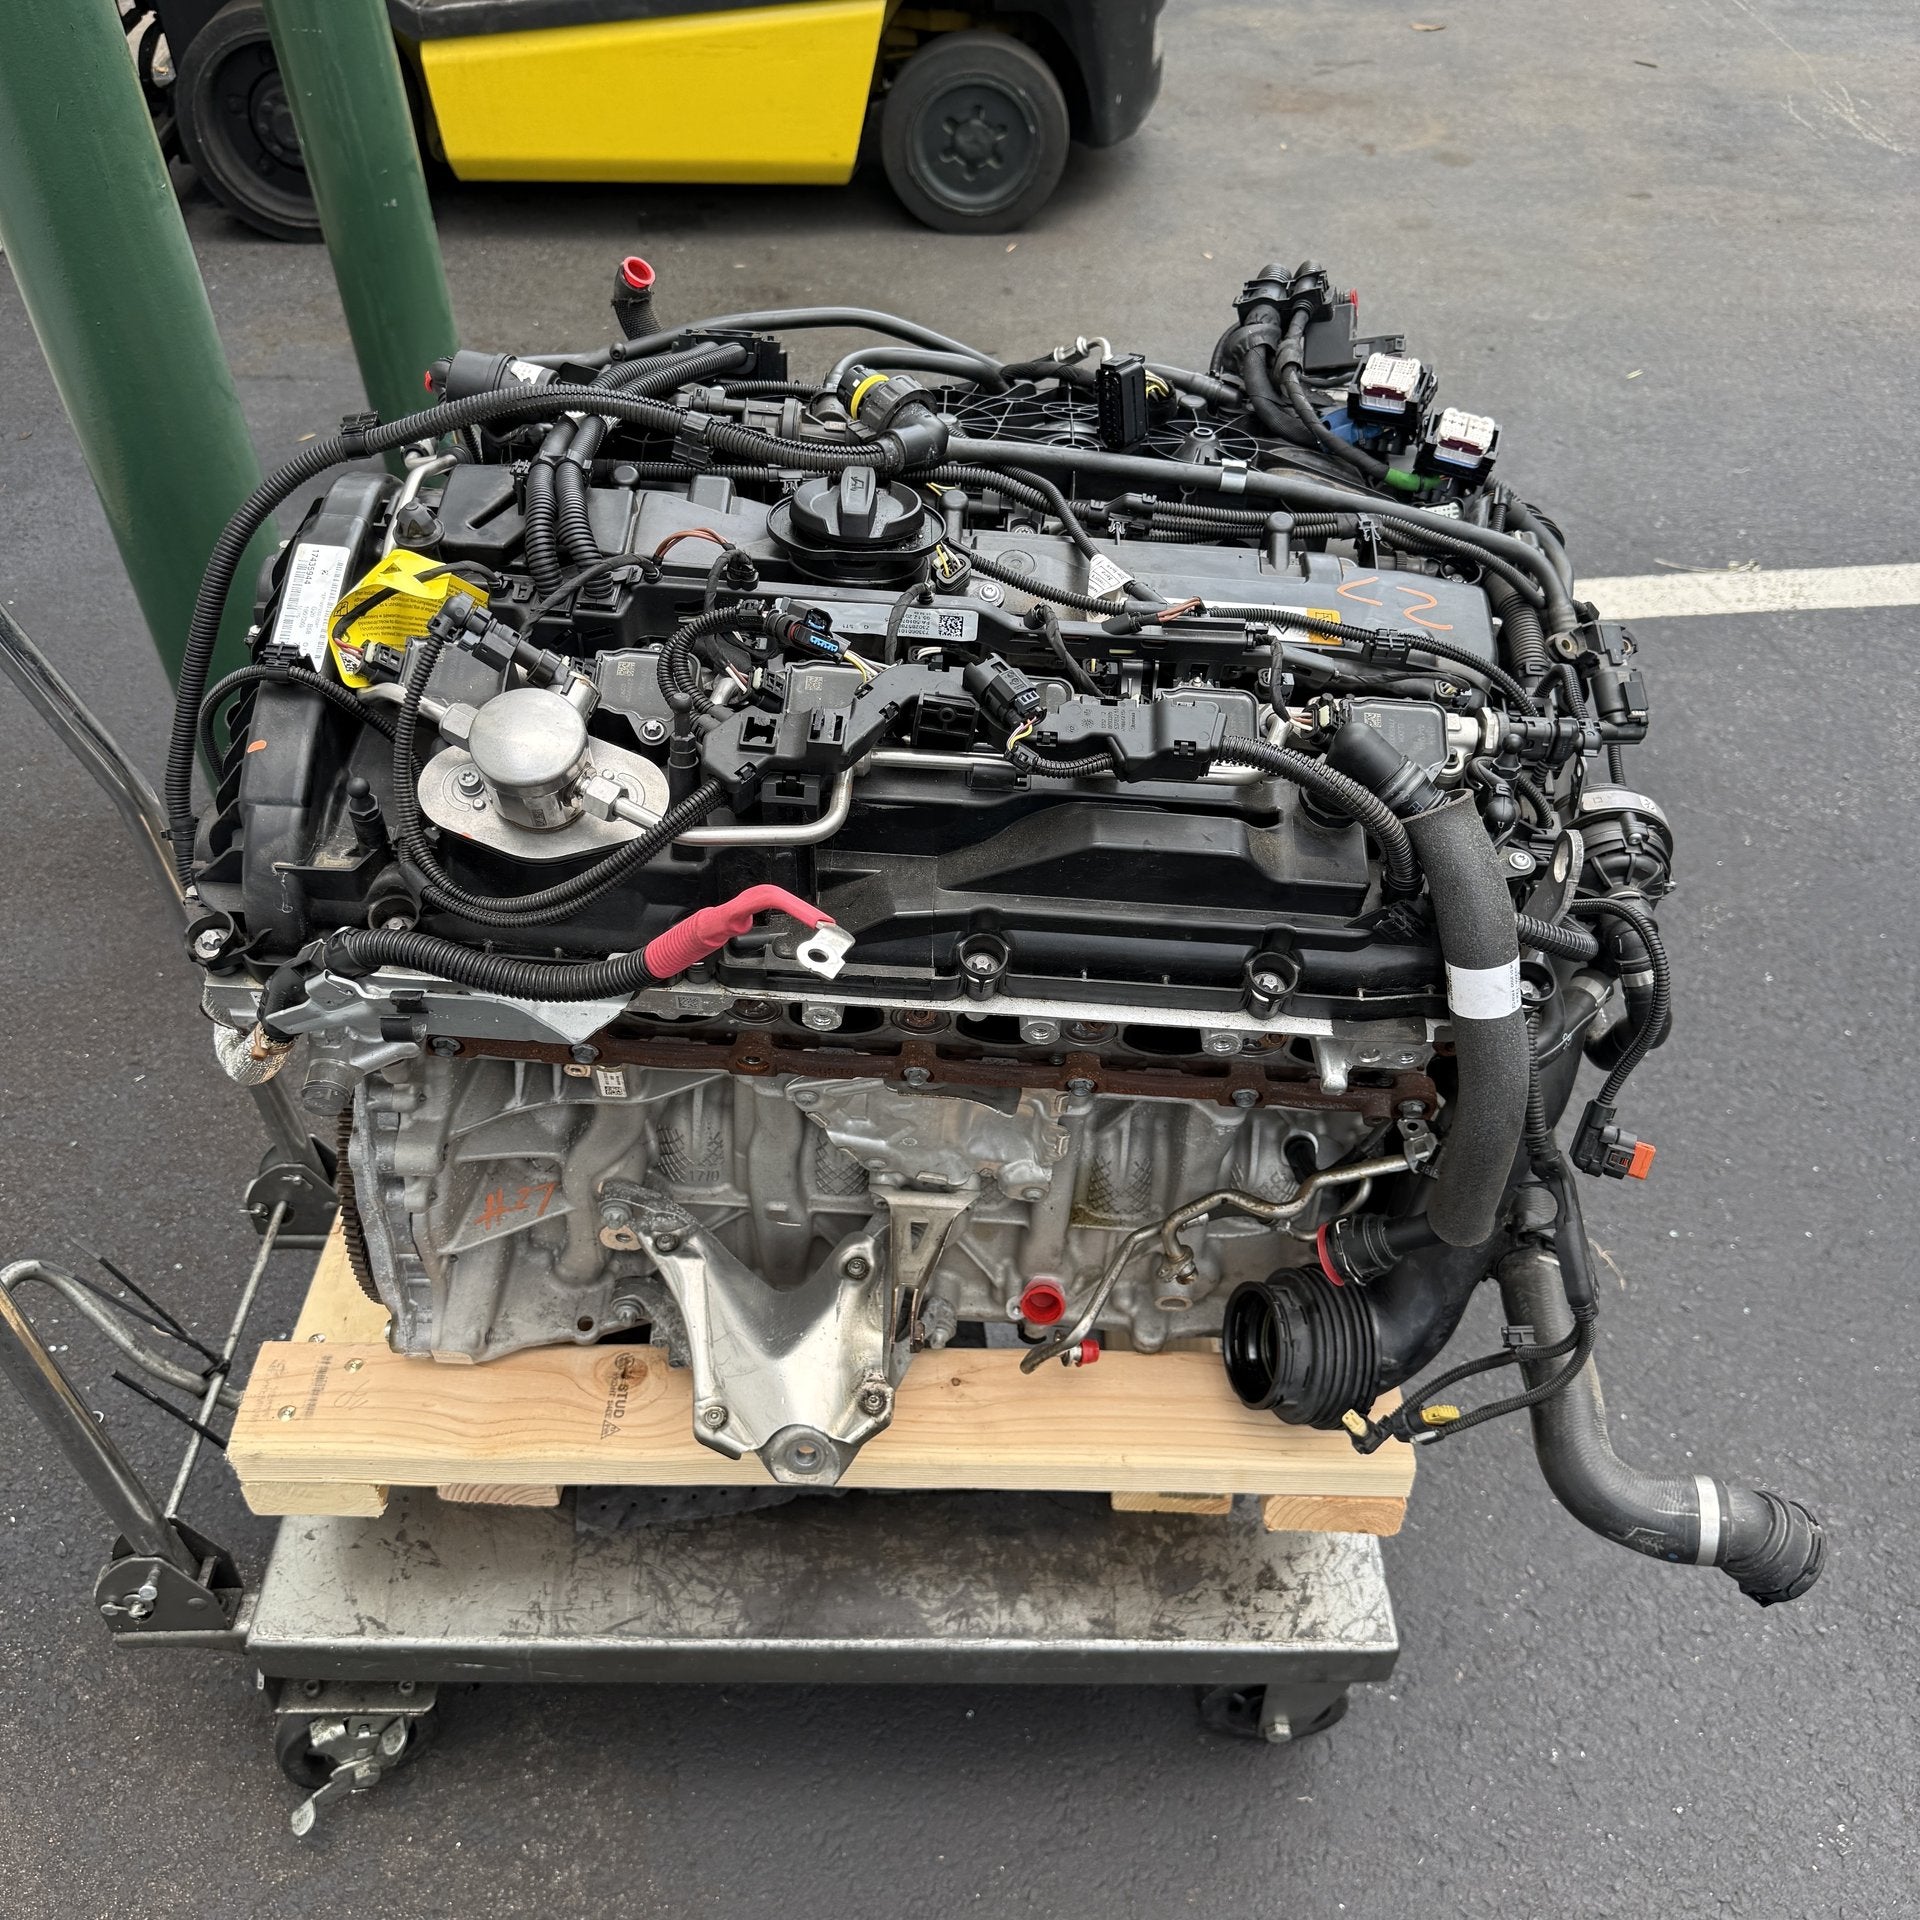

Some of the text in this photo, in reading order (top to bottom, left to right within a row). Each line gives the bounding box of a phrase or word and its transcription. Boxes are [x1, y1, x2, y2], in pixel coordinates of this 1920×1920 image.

[304, 549, 320, 585] 17435944
[474, 1181, 560, 1231] #27
[613, 1383, 629, 1419] STUD
